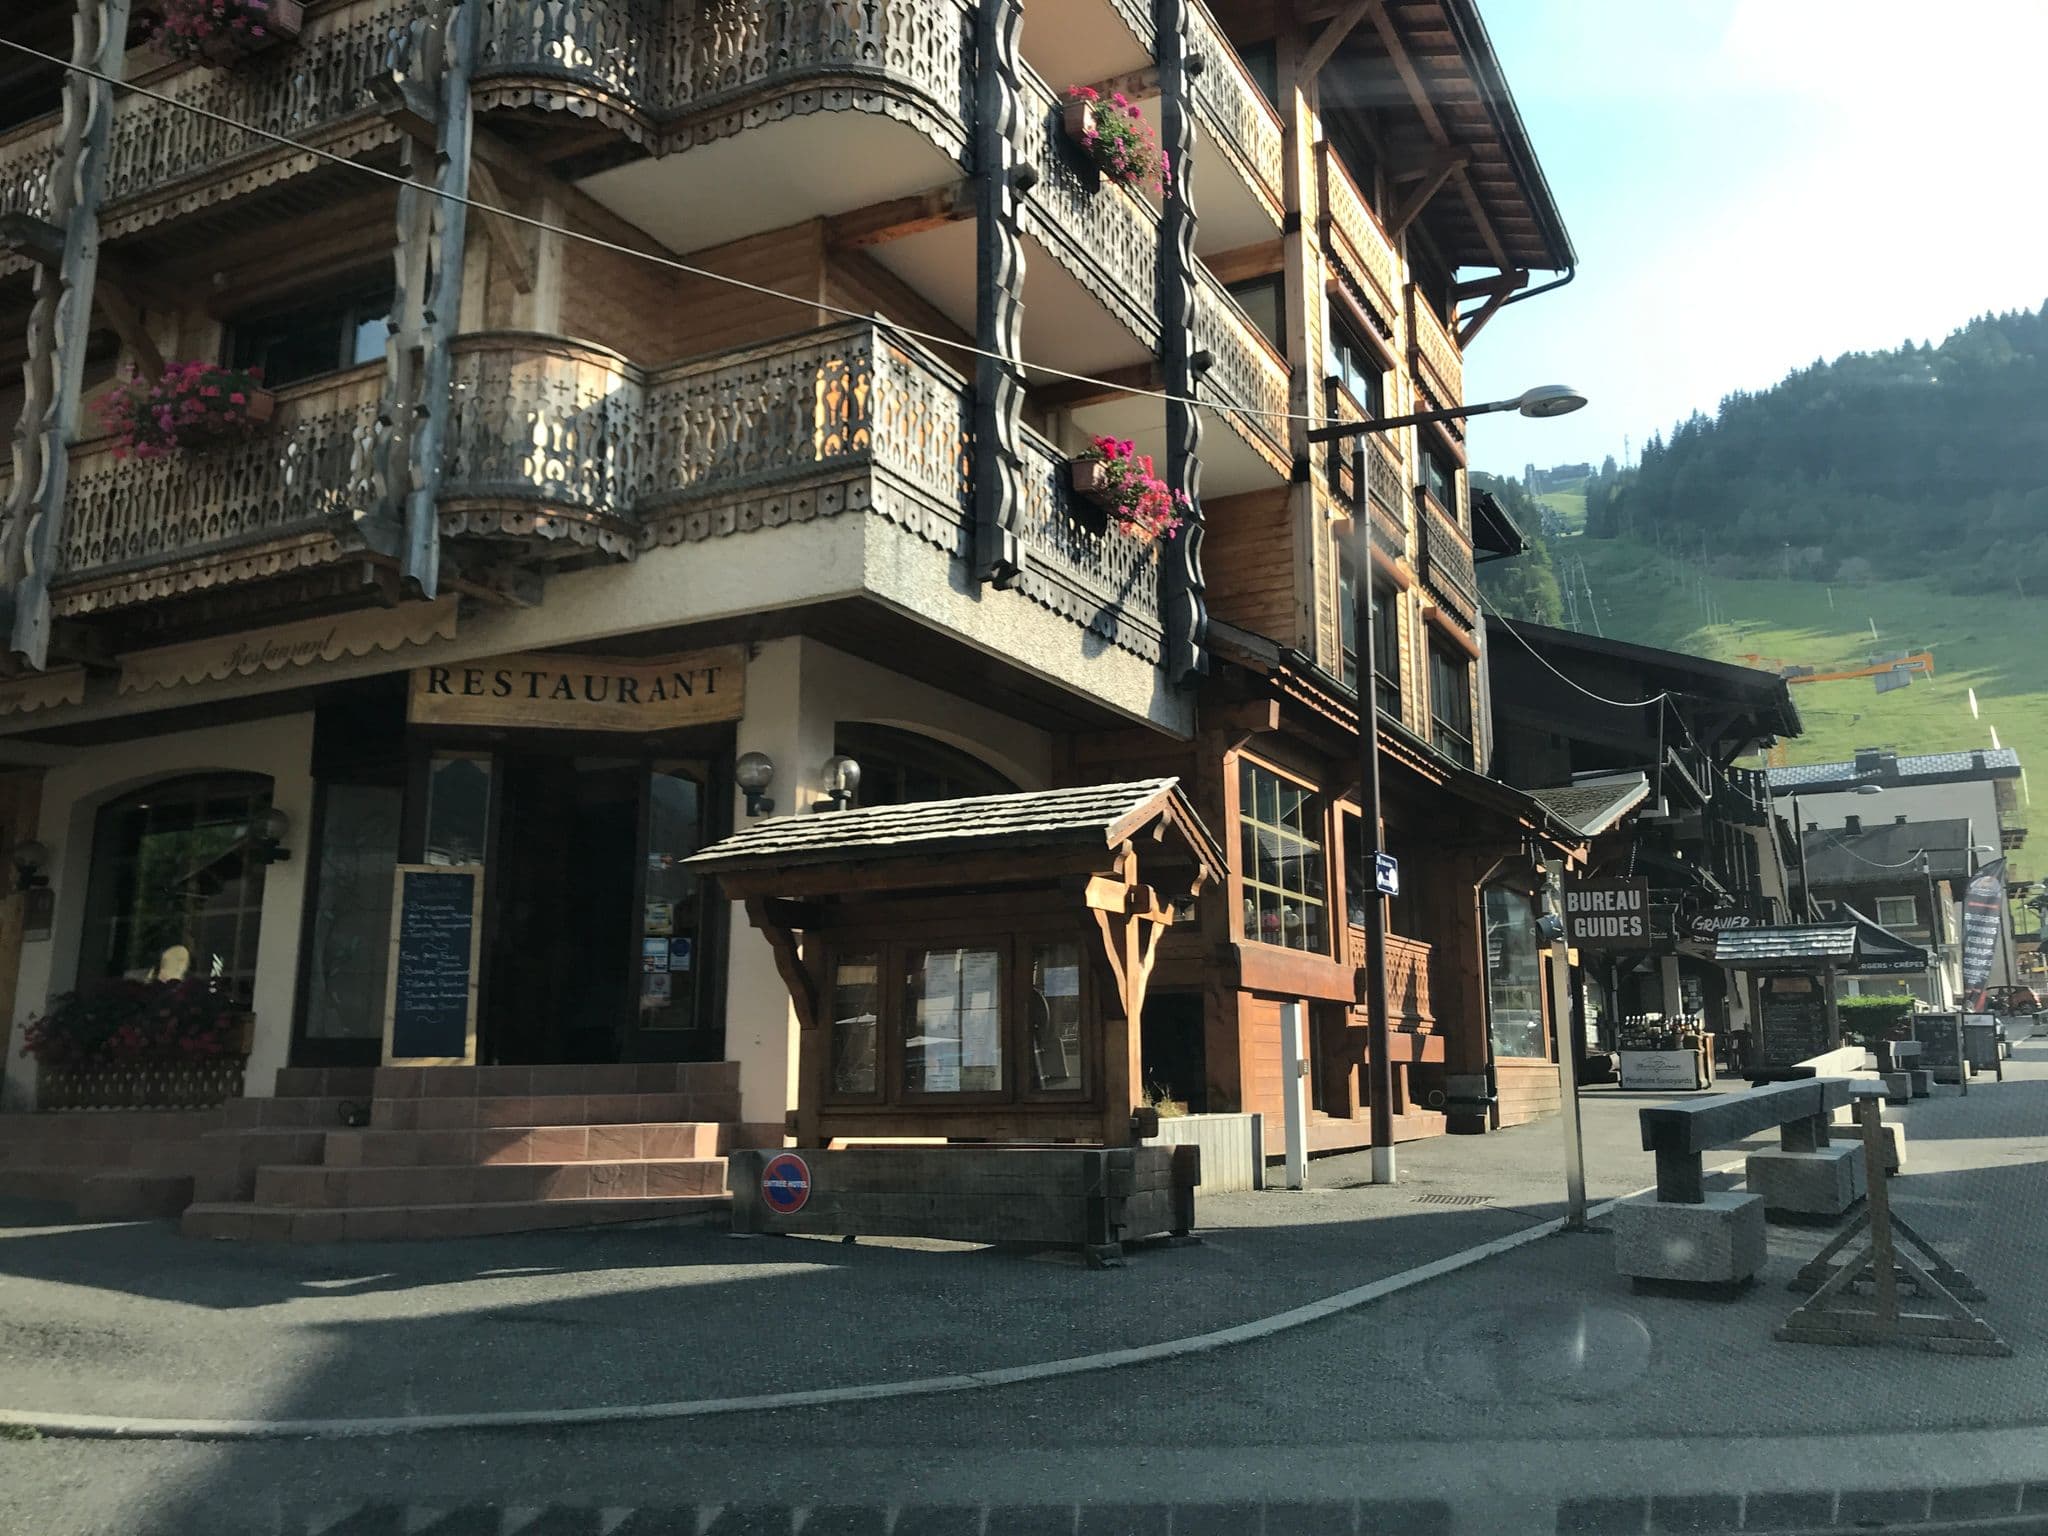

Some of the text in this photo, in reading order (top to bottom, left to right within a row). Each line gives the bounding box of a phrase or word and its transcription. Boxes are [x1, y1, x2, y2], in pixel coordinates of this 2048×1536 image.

[425, 666, 722, 703] RESTAURANT
[1567, 890, 1641, 912] BUREAU
[1574, 915, 1643, 938] GUIDES
[1691, 915, 1750, 932] GRAVIER
[1964, 912, 2000, 924] BURGERS
[1967, 936, 1994, 946] KEBAB
